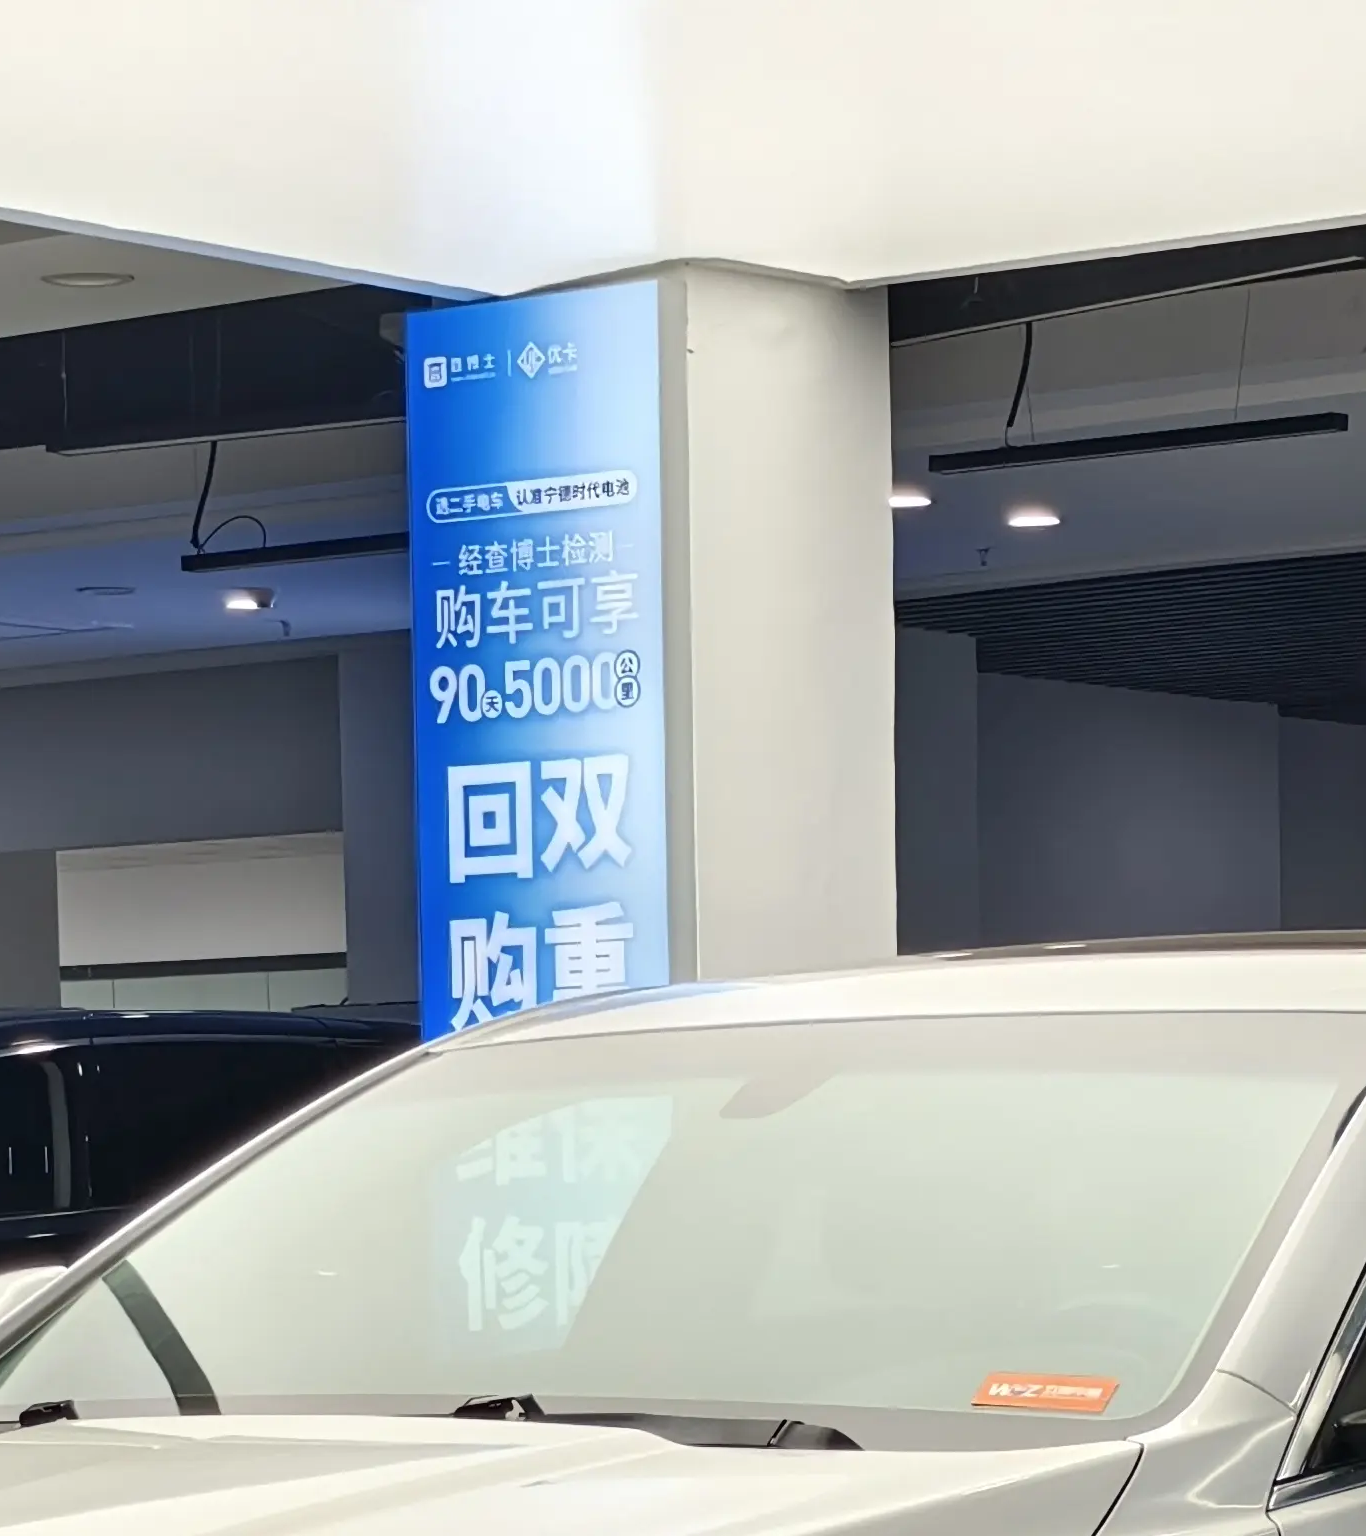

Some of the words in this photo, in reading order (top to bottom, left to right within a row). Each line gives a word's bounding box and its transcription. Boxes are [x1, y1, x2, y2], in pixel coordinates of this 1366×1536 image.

[458, 530, 614, 576] 经查博士检测
[436, 569, 639, 650] 购车可享
